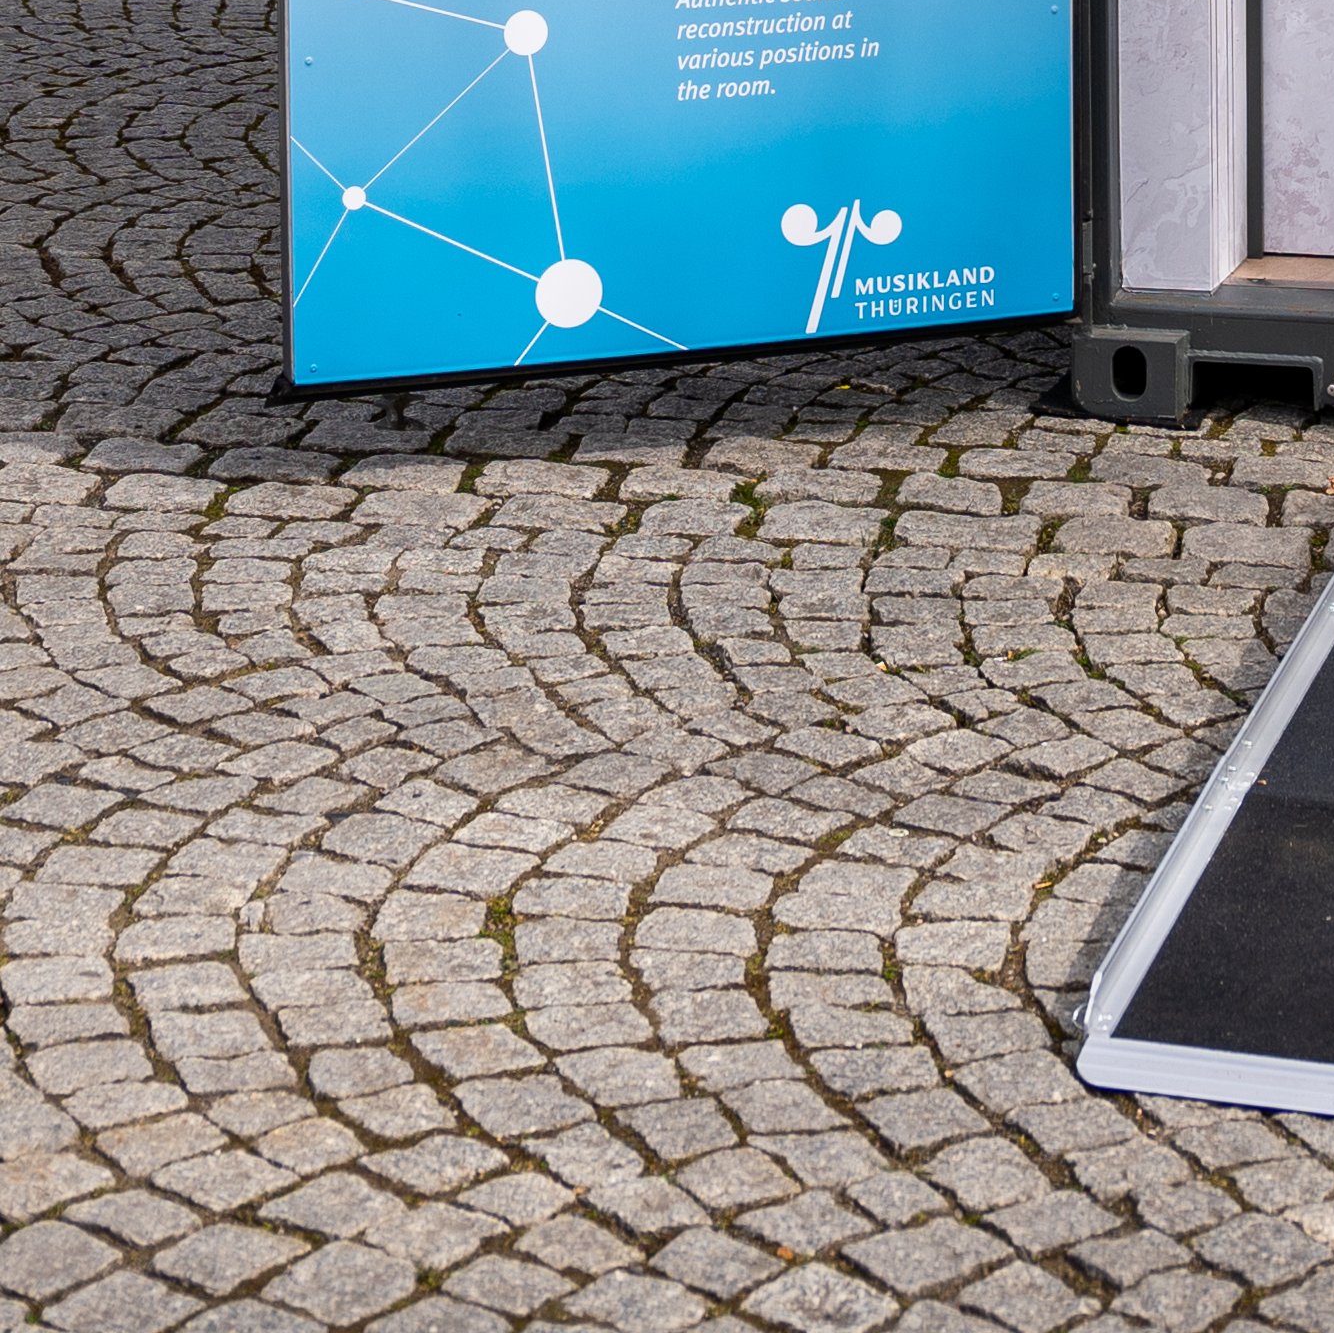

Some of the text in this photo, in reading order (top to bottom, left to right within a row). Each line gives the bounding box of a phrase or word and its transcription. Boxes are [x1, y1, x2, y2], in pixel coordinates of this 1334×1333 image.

[677, 11, 853, 39] reconstruction at
[678, 38, 879, 70] various positions in
[678, 80, 775, 101] the room.
[856, 266, 994, 295] MUSIKLAND
[855, 289, 994, 319] THÜRINGEN
